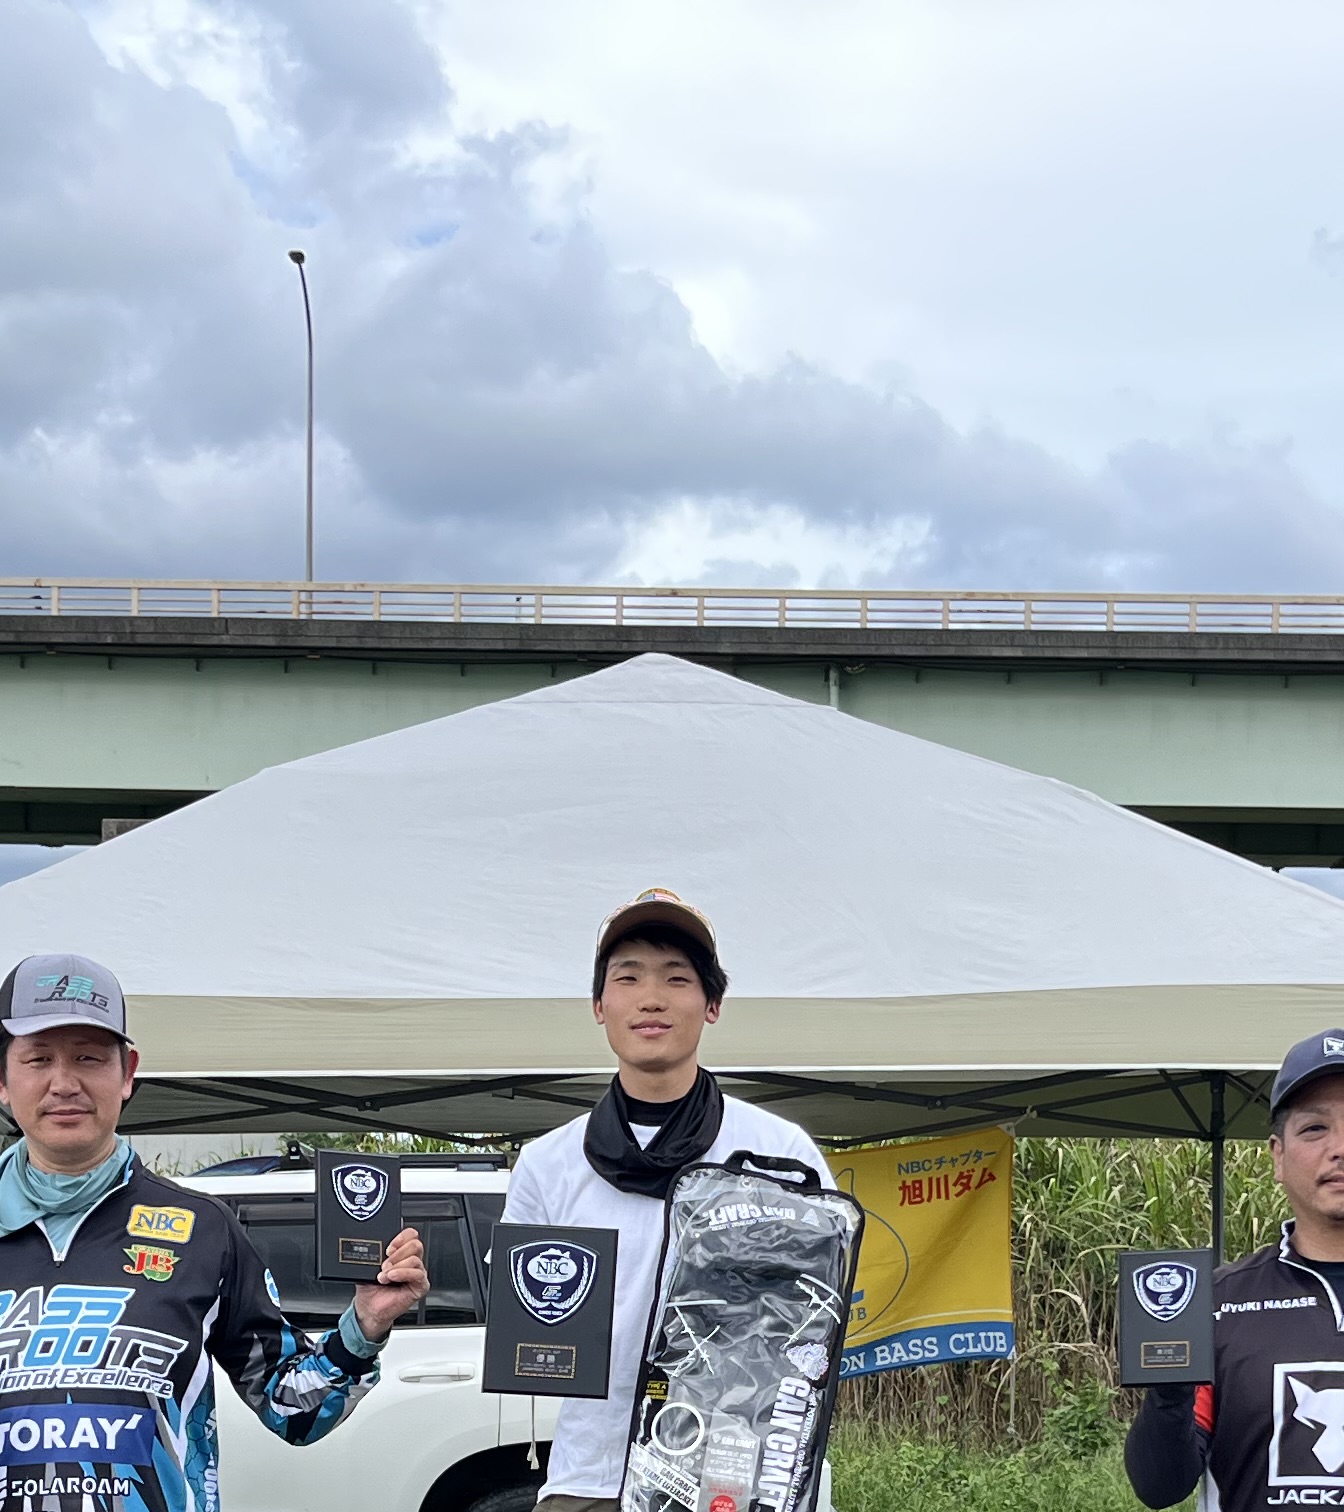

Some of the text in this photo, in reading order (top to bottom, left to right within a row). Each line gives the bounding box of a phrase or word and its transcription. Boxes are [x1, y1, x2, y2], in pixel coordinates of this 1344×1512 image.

[898, 1150, 996, 1175] NBCチャプター
[349, 1178, 371, 1188] NBC
[898, 1168, 997, 1207] 旭川ダム
[135, 1212, 186, 1233] NBC
[123, 1251, 174, 1275] JB
[536, 1260, 568, 1275] NBC
[1153, 1276, 1176, 1287] NBC
[1263, 1297, 1317, 1310] NAGASE
[874, 1336, 939, 1367] BASS
[949, 1331, 1007, 1355] CLUB
[60, 1367, 174, 1398] Excellence
[770, 1376, 810, 1432] GAN
[11, 1476, 131, 1498] SOLAROAM
